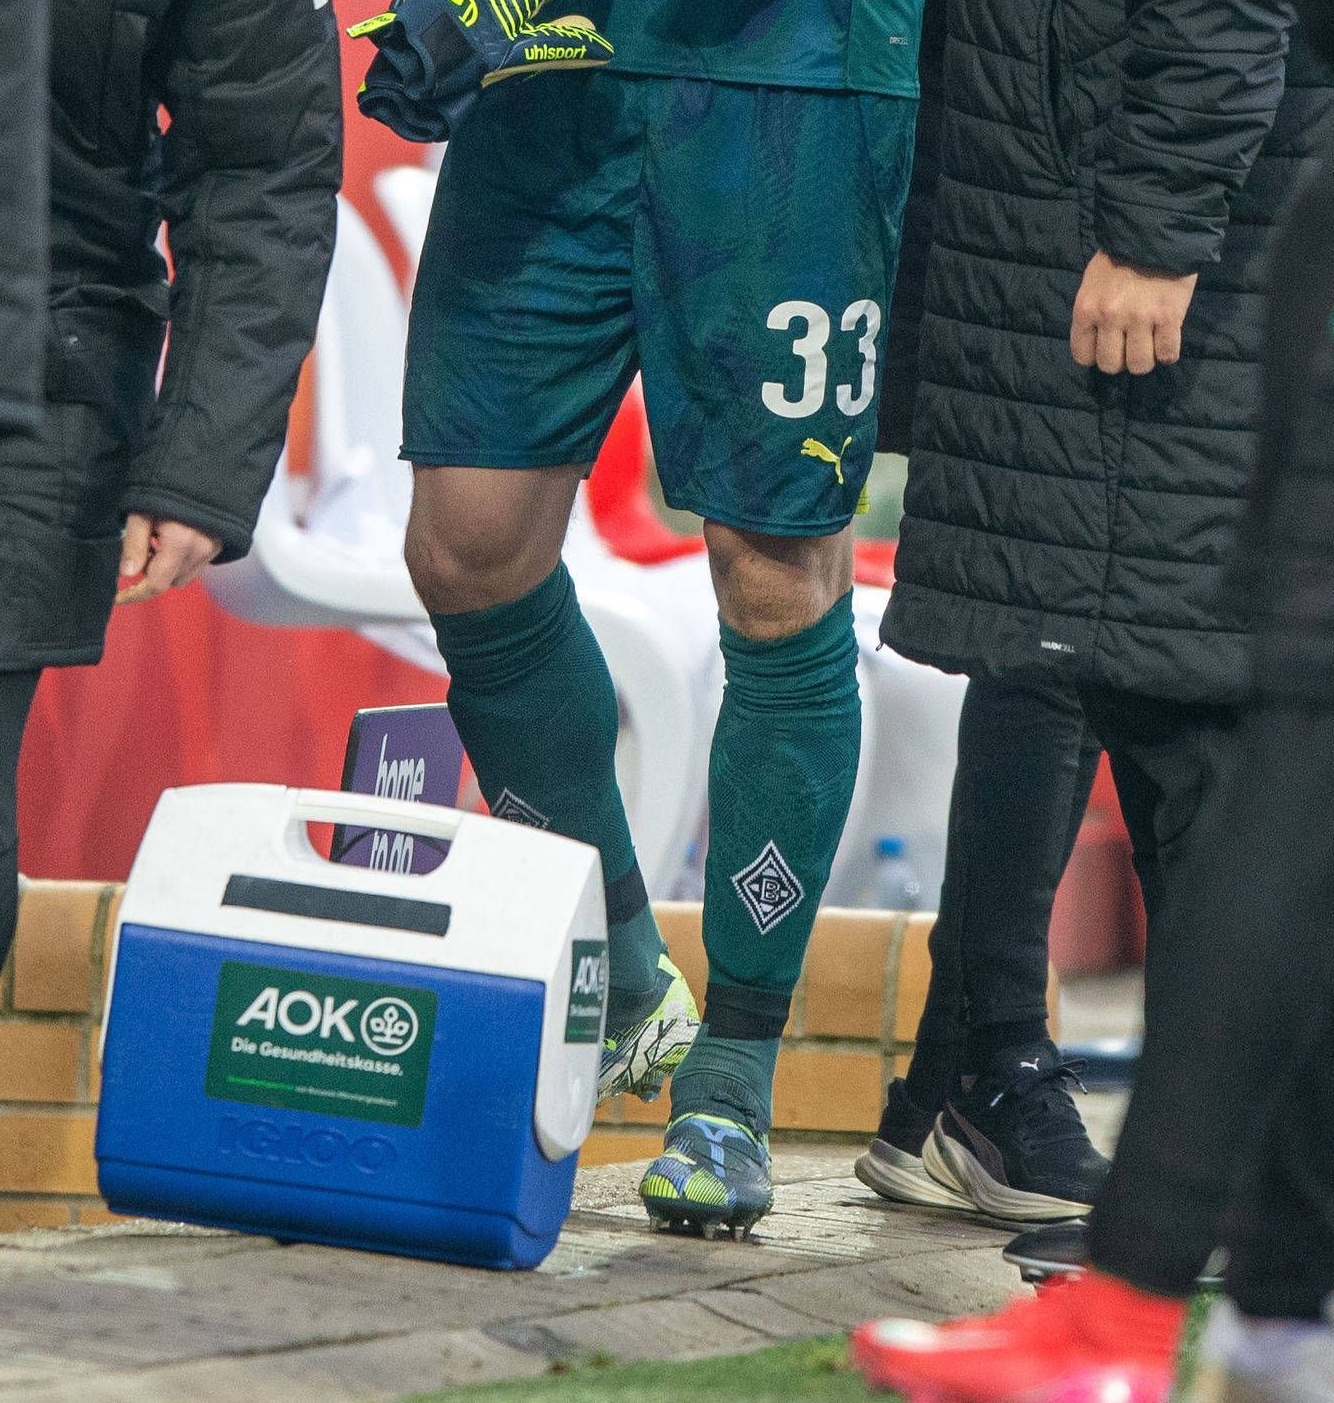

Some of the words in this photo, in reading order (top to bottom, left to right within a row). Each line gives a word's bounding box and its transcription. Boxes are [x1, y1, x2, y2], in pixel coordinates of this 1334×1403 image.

[524, 43, 587, 61] uhlsport
[761, 299, 881, 419] 33
[375, 733, 426, 803] home
[235, 986, 360, 1043] AOK
[230, 1036, 257, 1055] Die
[258, 1041, 404, 1077] Gesundheitskasse.
